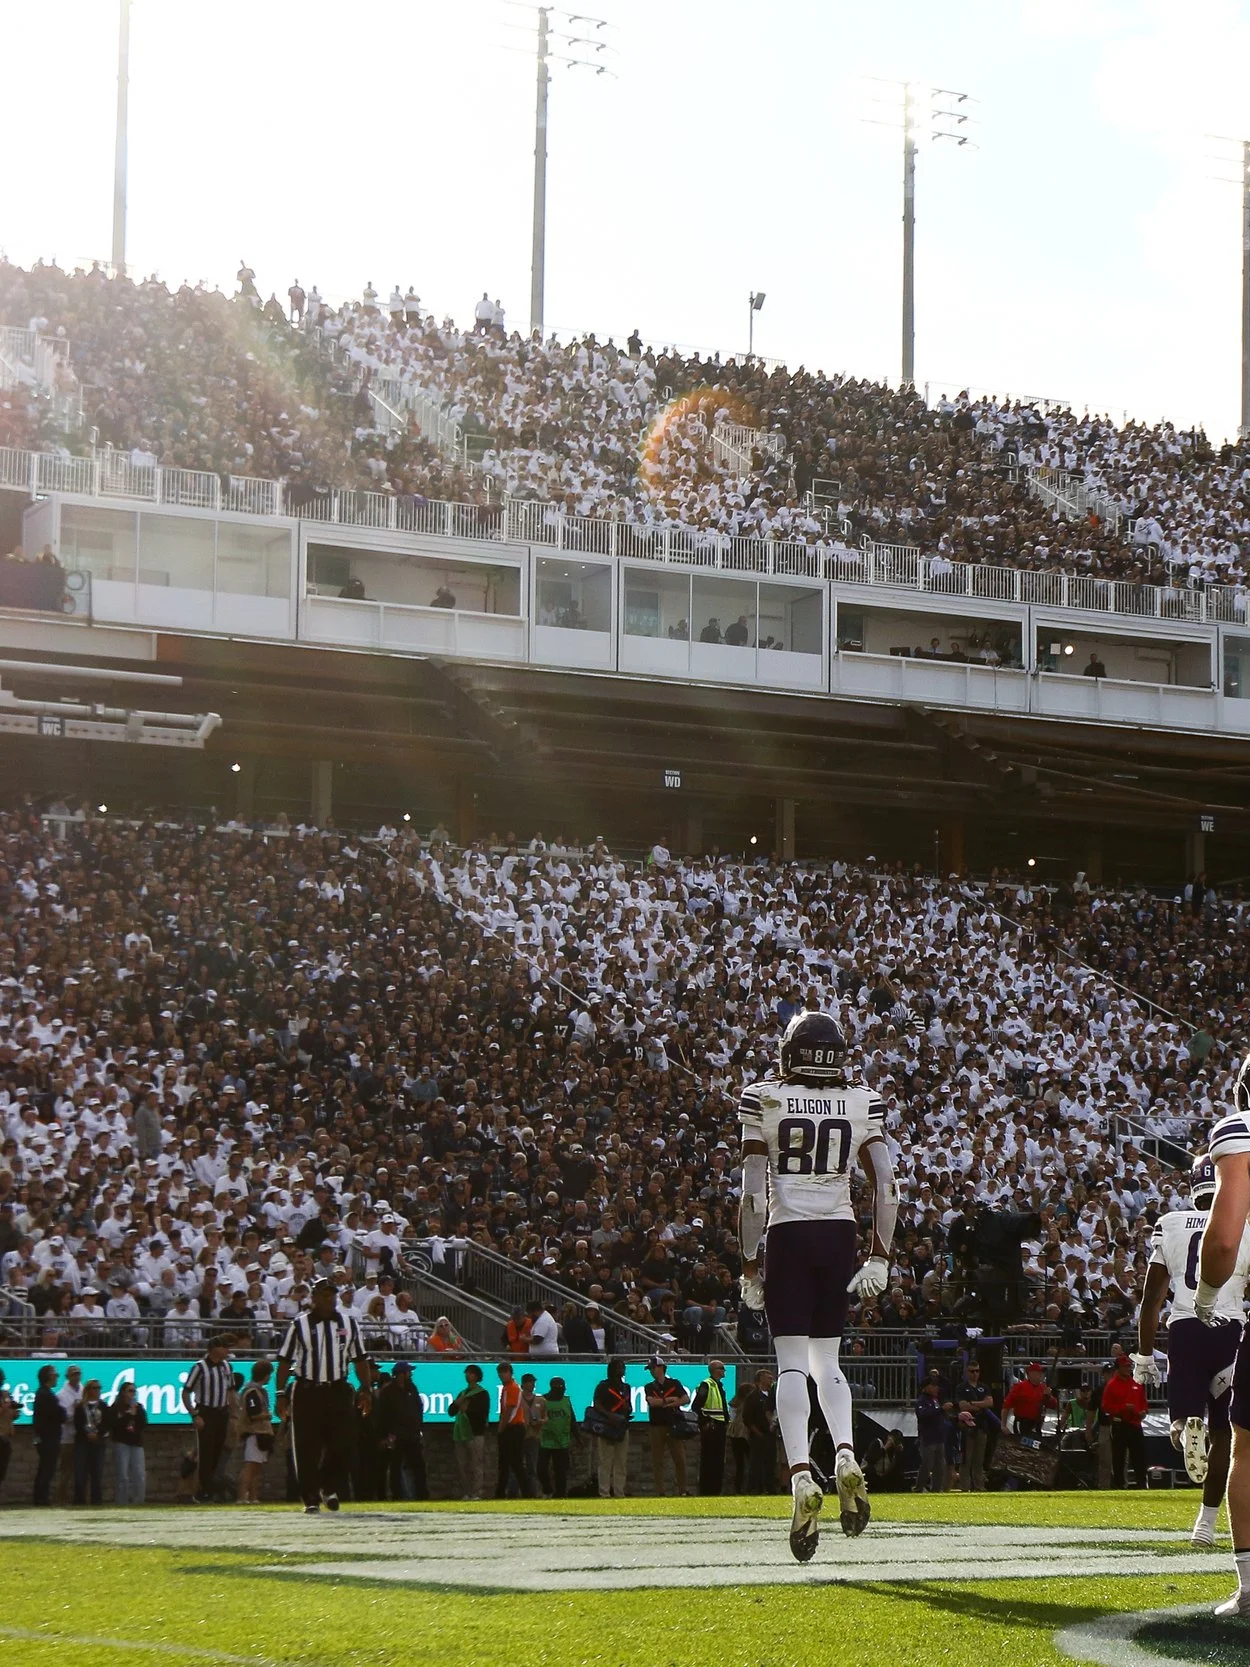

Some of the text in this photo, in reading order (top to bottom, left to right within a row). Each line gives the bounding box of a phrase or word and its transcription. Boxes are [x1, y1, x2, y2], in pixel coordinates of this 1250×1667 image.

[42, 723, 61, 736] WC
[664, 775, 681, 788] WD
[1200, 821, 1214, 832] WE
[554, 1025, 569, 1038] 17
[814, 1049, 835, 1064] 80
[787, 1098, 846, 1116] ELIGON II
[778, 1118, 852, 1174] 80
[1204, 1165, 1211, 1177] 6
[1185, 1217, 1207, 1229] HIM
[100, 1368, 200, 1414] Ami
[421, 1393, 454, 1414] om
